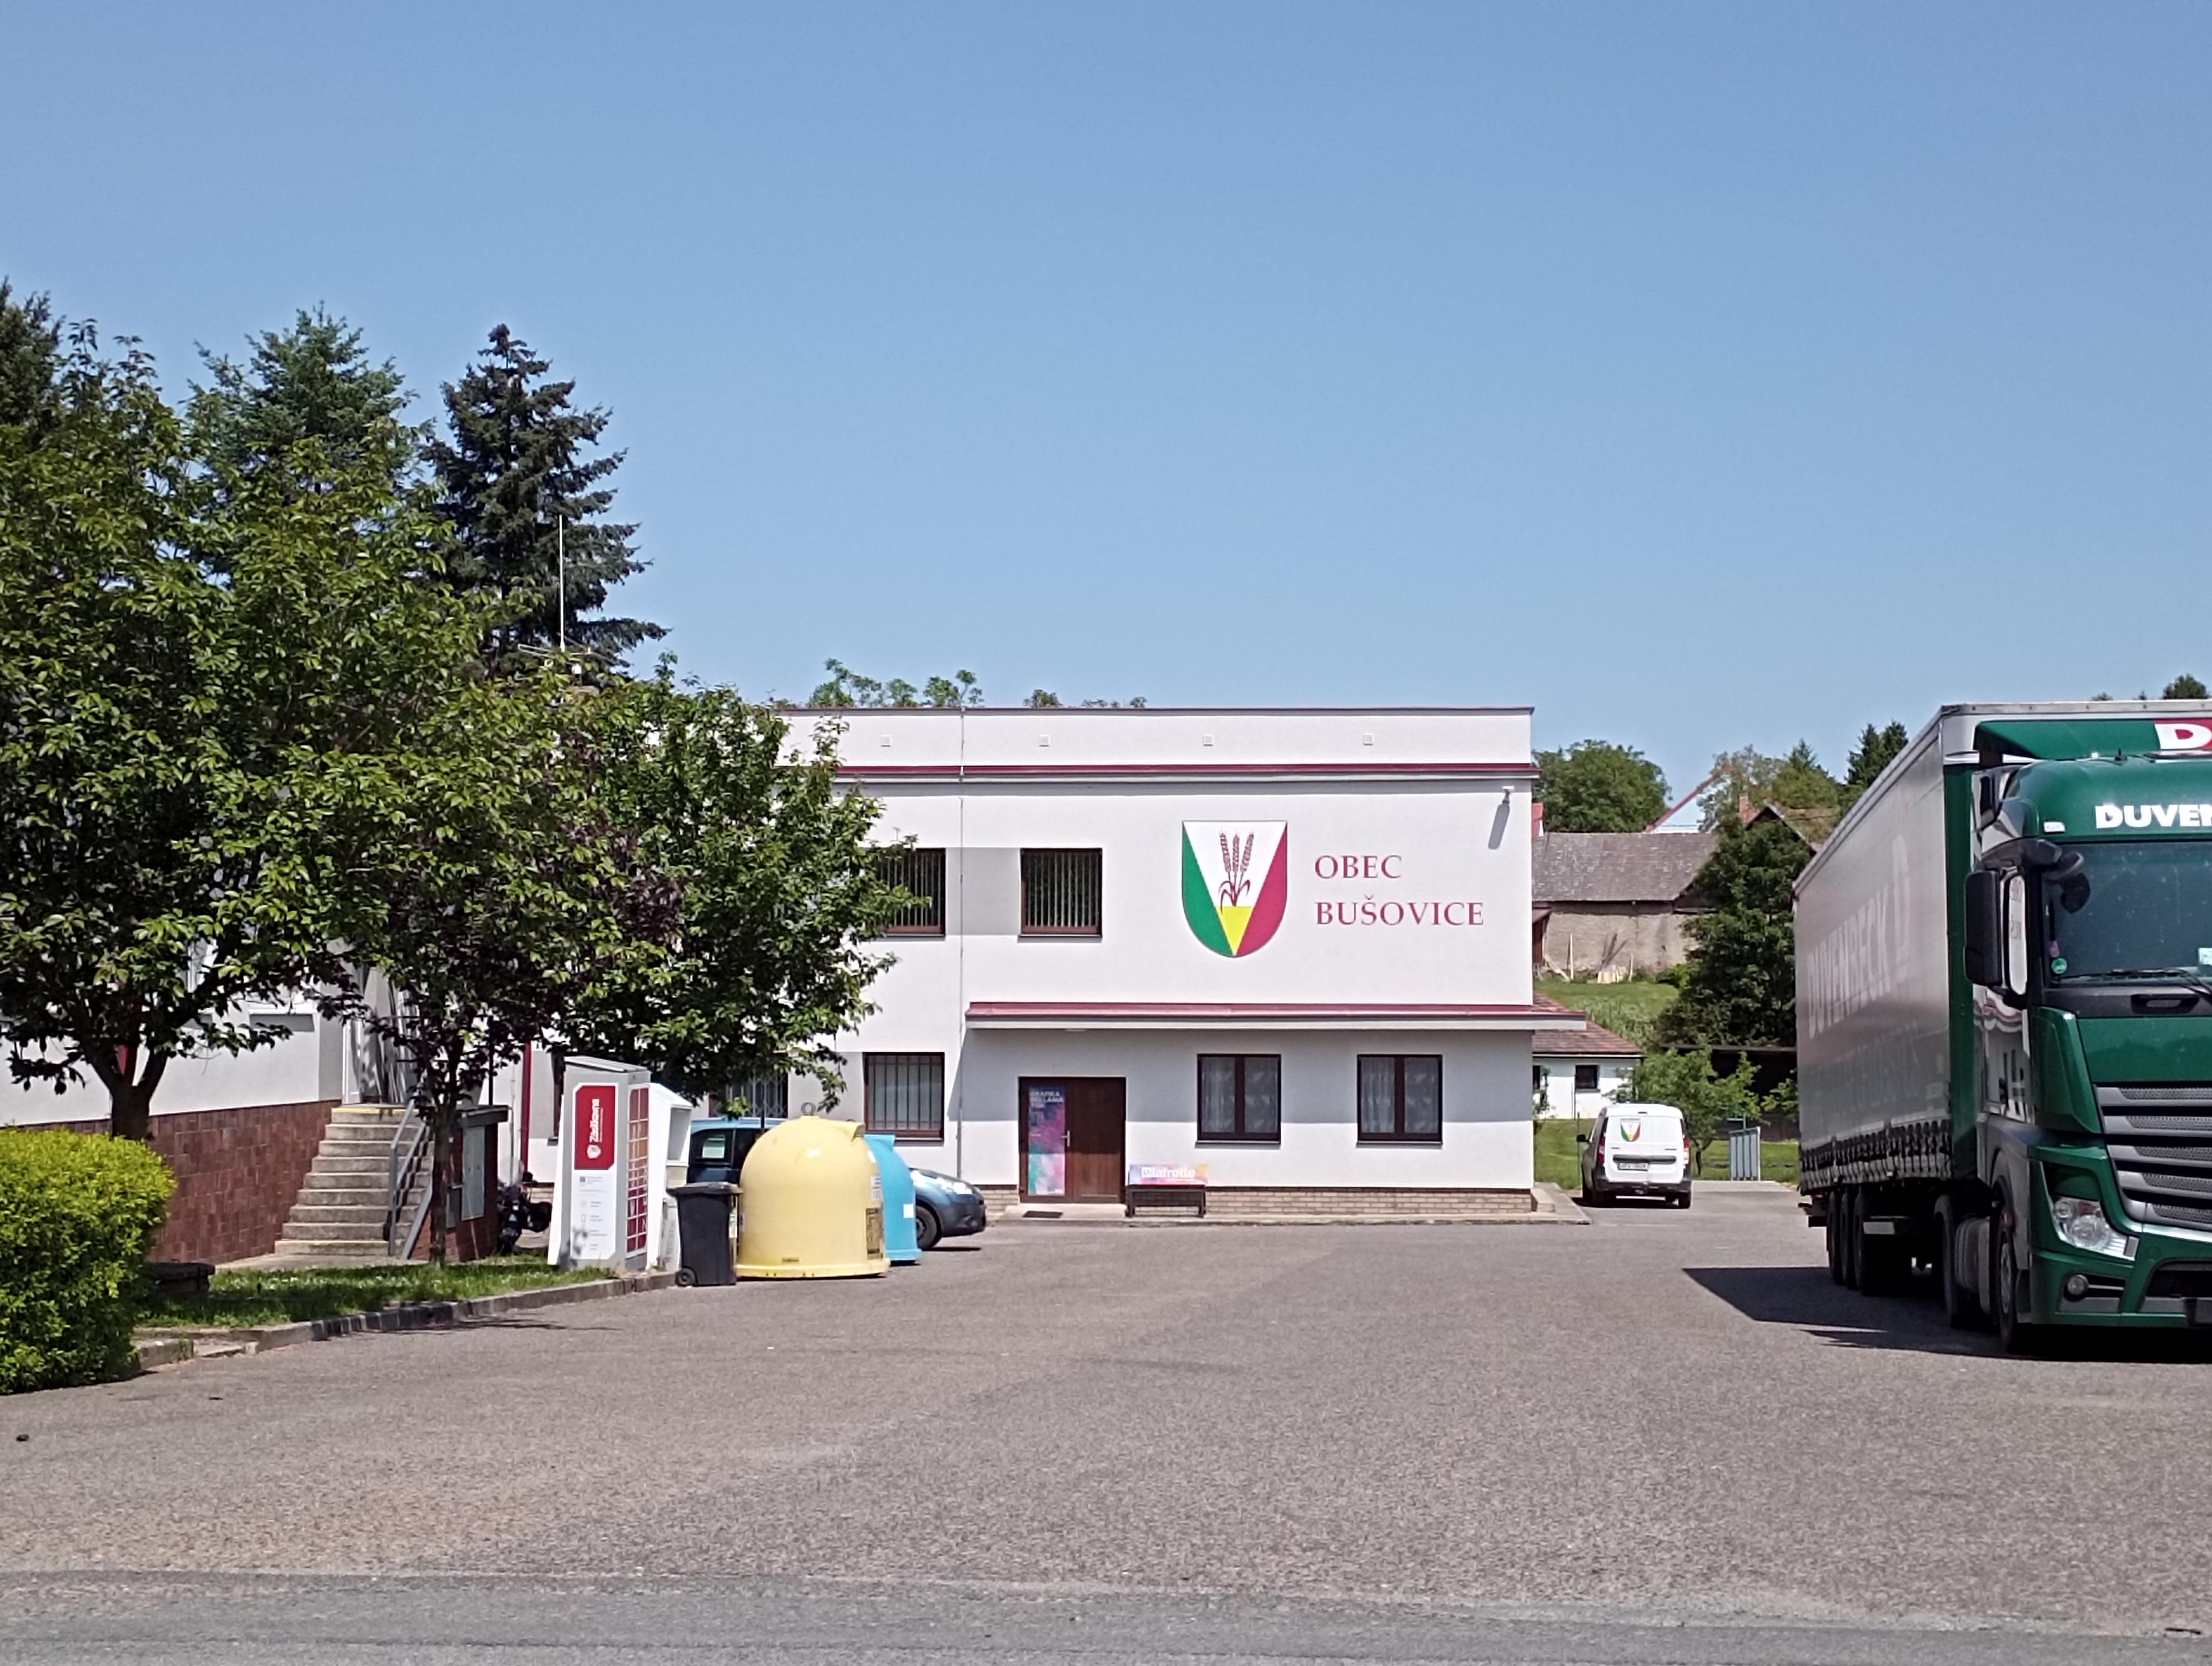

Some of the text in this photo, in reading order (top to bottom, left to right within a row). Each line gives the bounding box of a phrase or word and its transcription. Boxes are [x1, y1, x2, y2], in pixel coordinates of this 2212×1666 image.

[1314, 855, 1403, 879] OBEC
[1315, 894, 1484, 926] BUŠOVICE
[1807, 885, 1891, 1040] DUVENBECK
